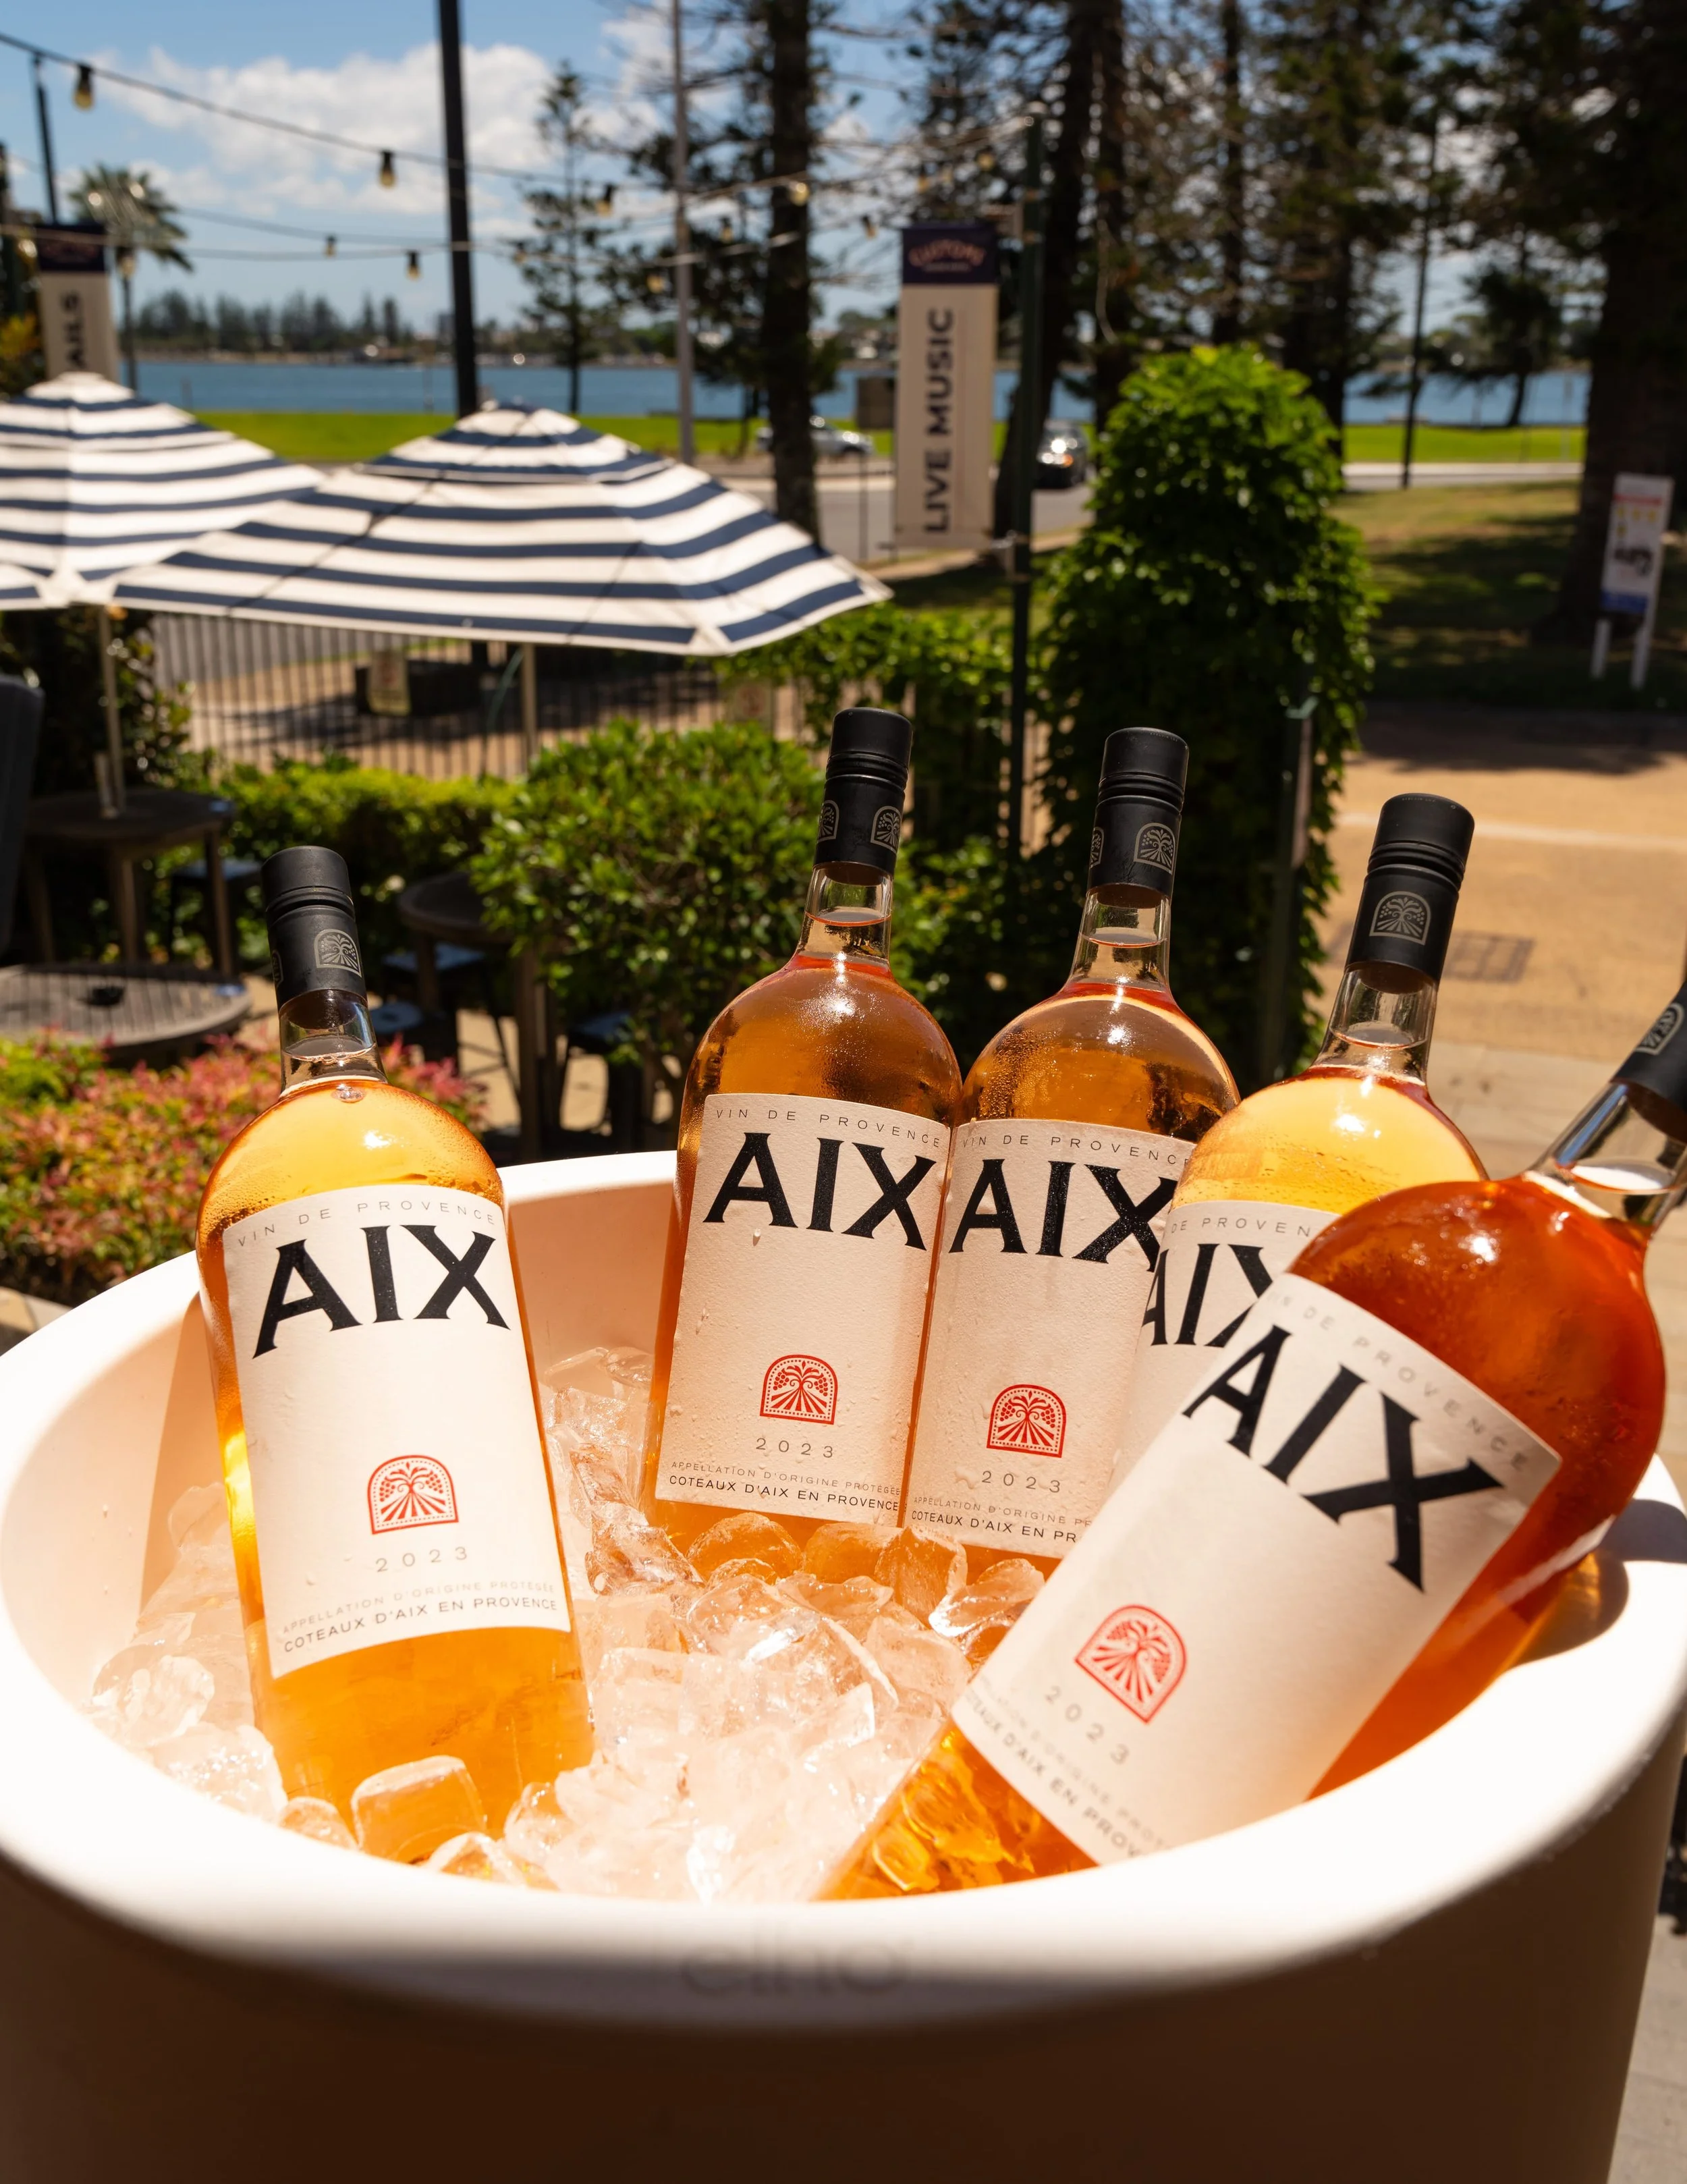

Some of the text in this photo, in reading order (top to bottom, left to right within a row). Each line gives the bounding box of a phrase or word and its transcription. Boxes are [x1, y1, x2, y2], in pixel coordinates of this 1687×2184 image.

[924, 308, 953, 533] LIVE MUSIC
[716, 1109, 940, 1148] VIN DE PROVENCE
[962, 1136, 987, 1148] VIN
[1003, 1135, 1029, 1145] DE
[702, 1132, 937, 1251] AIX
[238, 1200, 495, 1247] VIN DE PROVENCE
[948, 1159, 1178, 1273] AIX
[1171, 1217, 1311, 1237] DE PROVEN
[252, 1224, 511, 1359] AIX
[1303, 1306, 1528, 1471] DE PROVENCE
[755, 1438, 833, 1458] 2023
[1181, 1323, 1507, 1594] AIX
[669, 1475, 899, 1511] COTEAUX D'AIX EN PROVENCE
[671, 1461, 755, 1477] APPELLATION
[764, 1471, 838, 1488] D'ORIGINE
[981, 1470, 1061, 1493] 2023
[911, 1510, 963, 1526] COTEAUX
[970, 1518, 1013, 1533] D'AIX
[1022, 1525, 1045, 1538] EN
[913, 1496, 981, 1511] APPELLATION
[989, 1505, 1066, 1524] D'ORIGINE
[376, 1546, 468, 1573] 2023
[283, 1595, 385, 1634] APPELLATION
[394, 1581, 482, 1601] D'ORIGINE
[284, 1597, 557, 1653] COTEAUX D'AIX EN PROVENCE
[1045, 1685, 1130, 1765] 2023
[1050, 1776, 1078, 1805] EN
[1082, 1806, 1144, 1857] PROV
